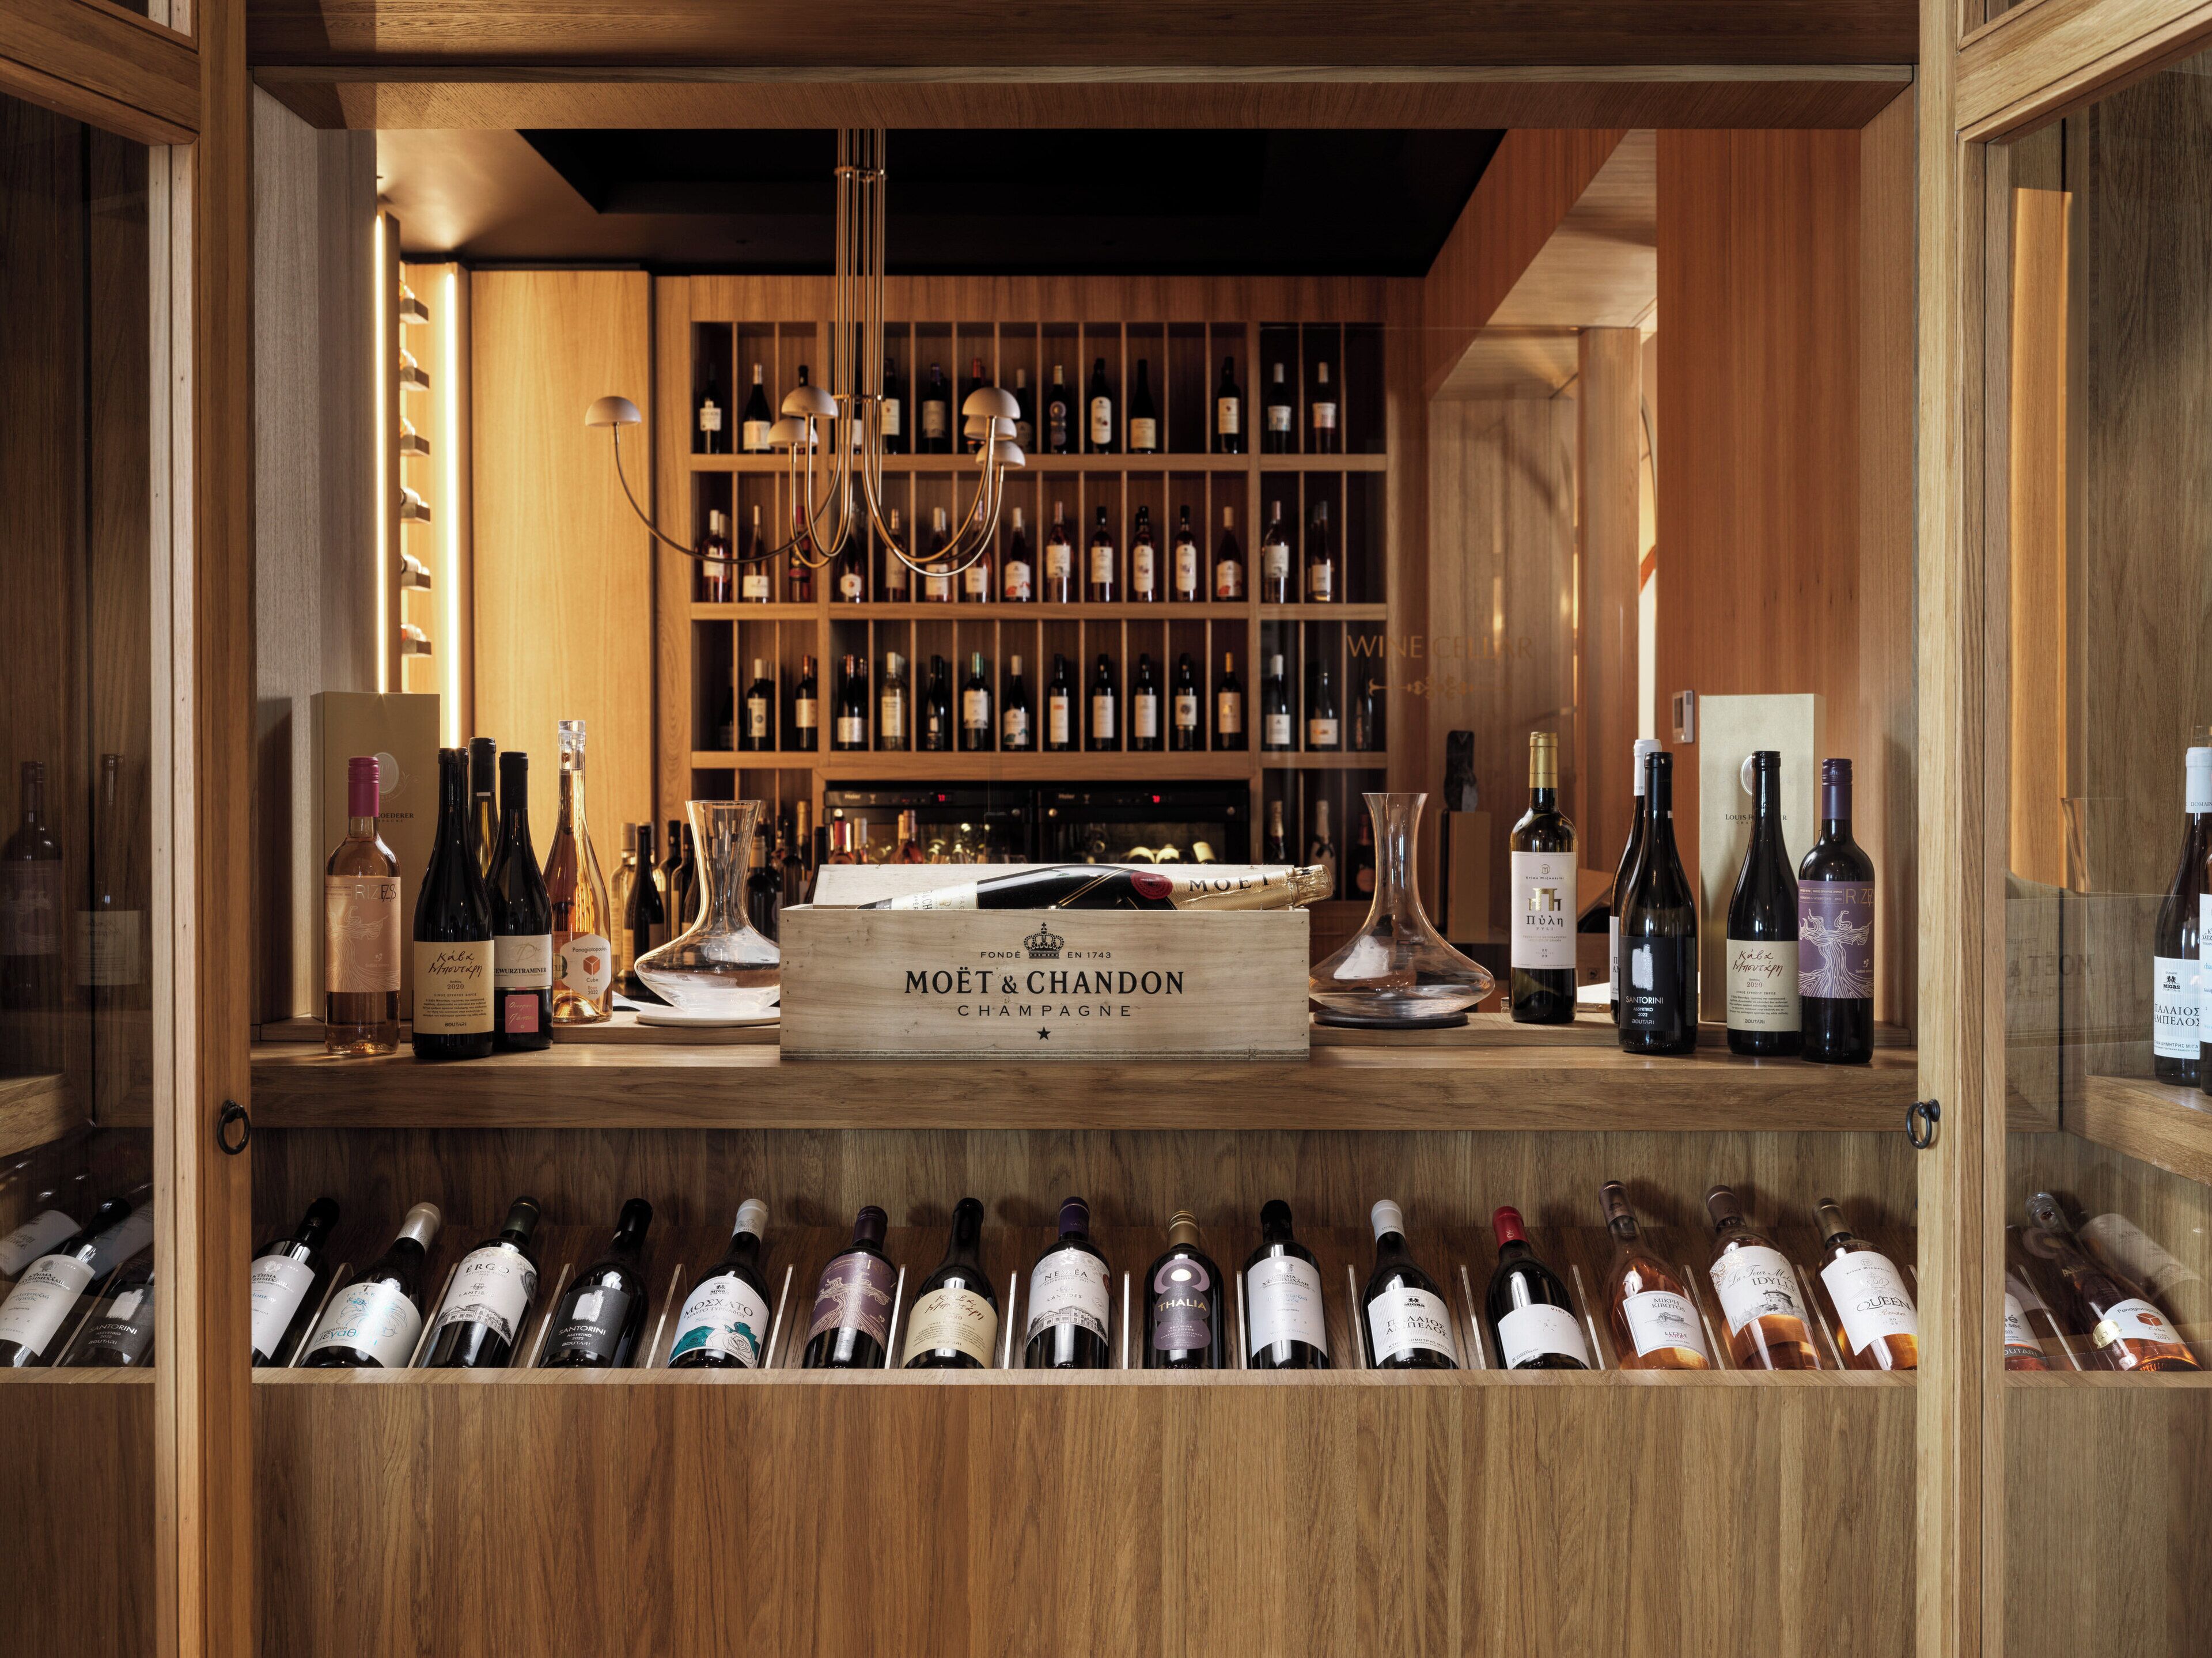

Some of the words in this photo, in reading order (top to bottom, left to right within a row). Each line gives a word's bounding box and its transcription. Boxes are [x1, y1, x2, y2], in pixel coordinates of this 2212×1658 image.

[1347, 635, 1423, 658] WINE
[1433, 635, 1535, 660] CELLAR
[904, 967, 993, 994] MOËT
[1002, 975, 1019, 994] &
[1027, 971, 1184, 994] CHANDON
[1626, 995, 1664, 1004] SANTORINI
[958, 1005, 1131, 1016] CHAMPAGNE
[1158, 1298, 1207, 1312] THALIA
[1857, 1295, 1911, 1312] QUEEN
[558, 1325, 606, 1335] SANTORINI
[1387, 1316, 1445, 1331] ΠΛΑΙΟΣ
[1387, 1322, 1448, 1339] ΑΠΕΛΟΣ
[2005, 1348, 2038, 1357] OUTARI
